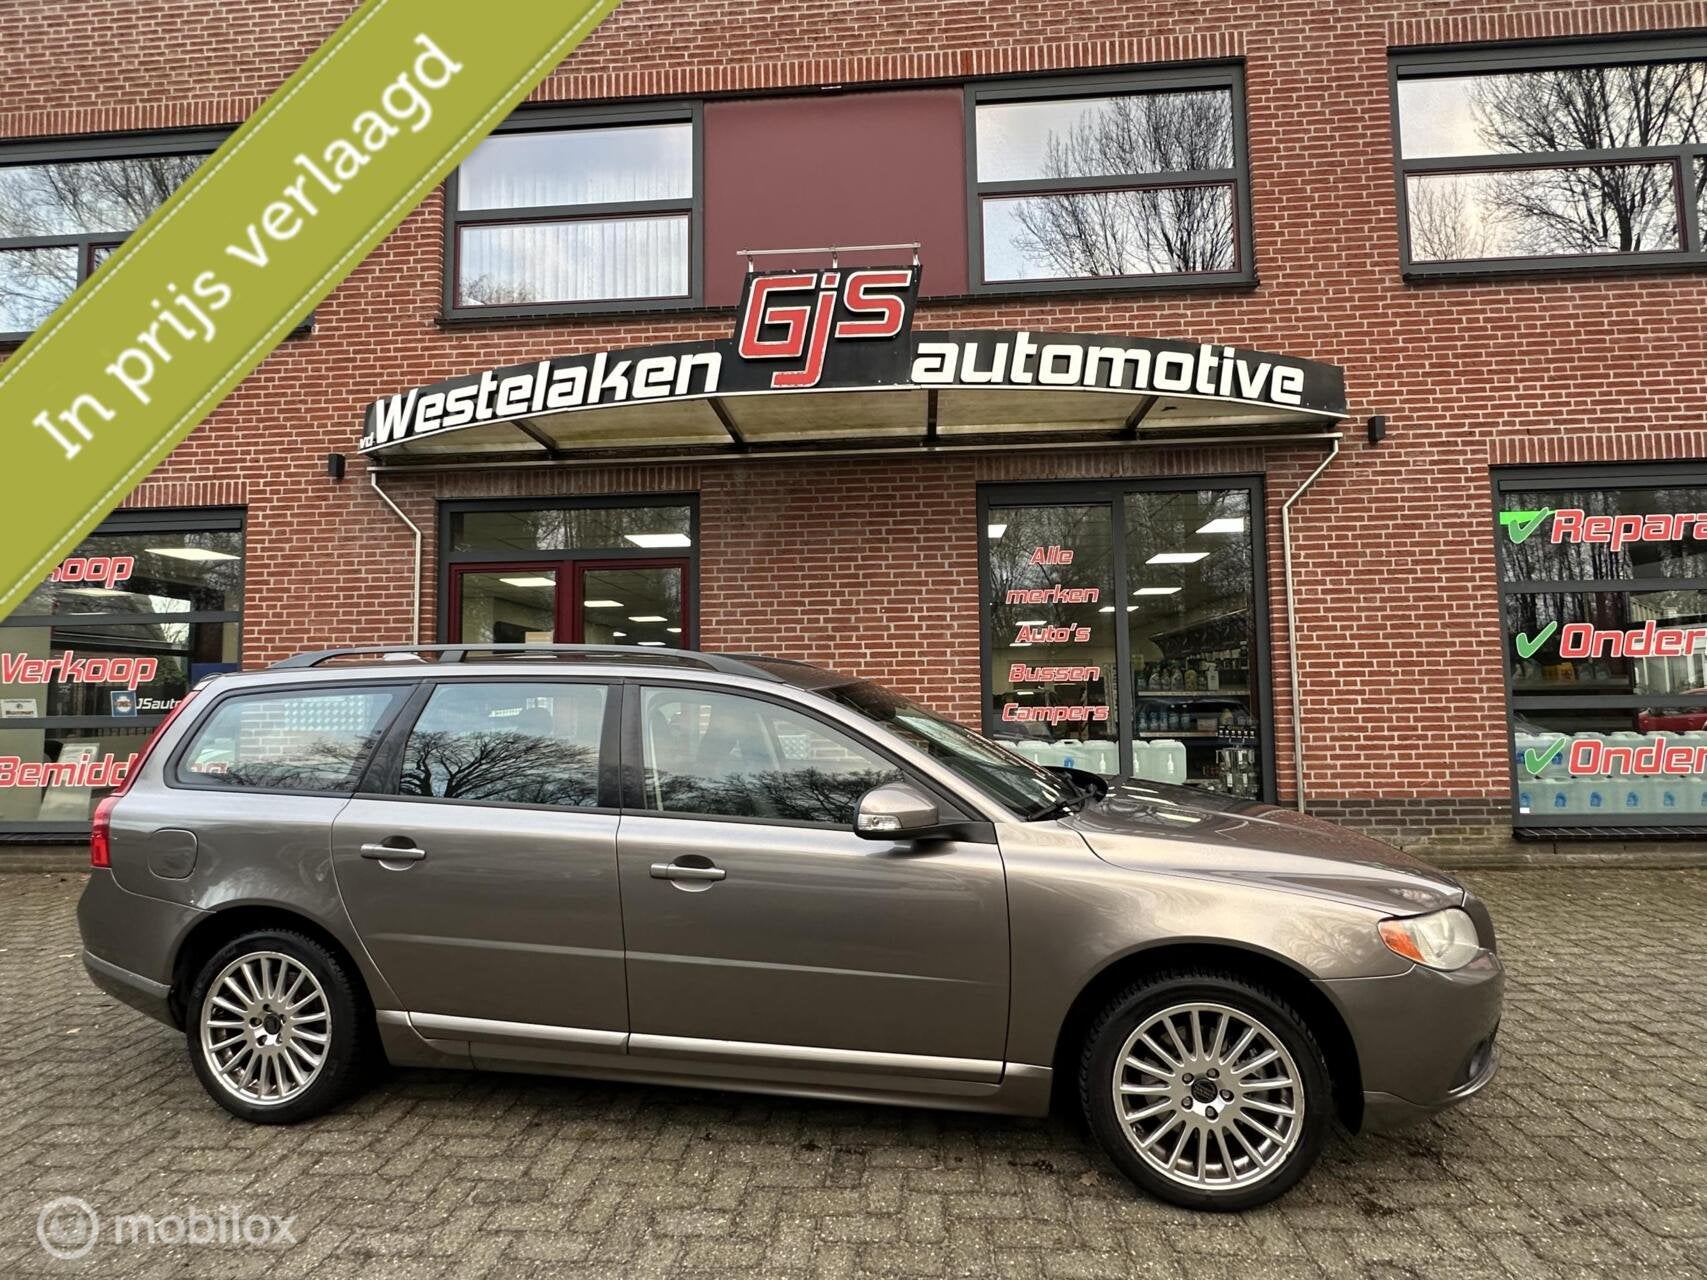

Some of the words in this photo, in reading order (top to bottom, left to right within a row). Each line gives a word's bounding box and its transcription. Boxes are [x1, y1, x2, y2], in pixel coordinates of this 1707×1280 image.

[376, 352, 722, 444] Westelaken
[911, 331, 1305, 405] automotive
[1029, 546, 1074, 565] Alle
[1005, 584, 1099, 605] merken
[1015, 623, 1091, 643] Auto's
[1559, 620, 1707, 658] Onder
[1, 650, 158, 690] Verkoop
[1008, 664, 1100, 683] Bussen
[1002, 703, 1109, 726] Campers
